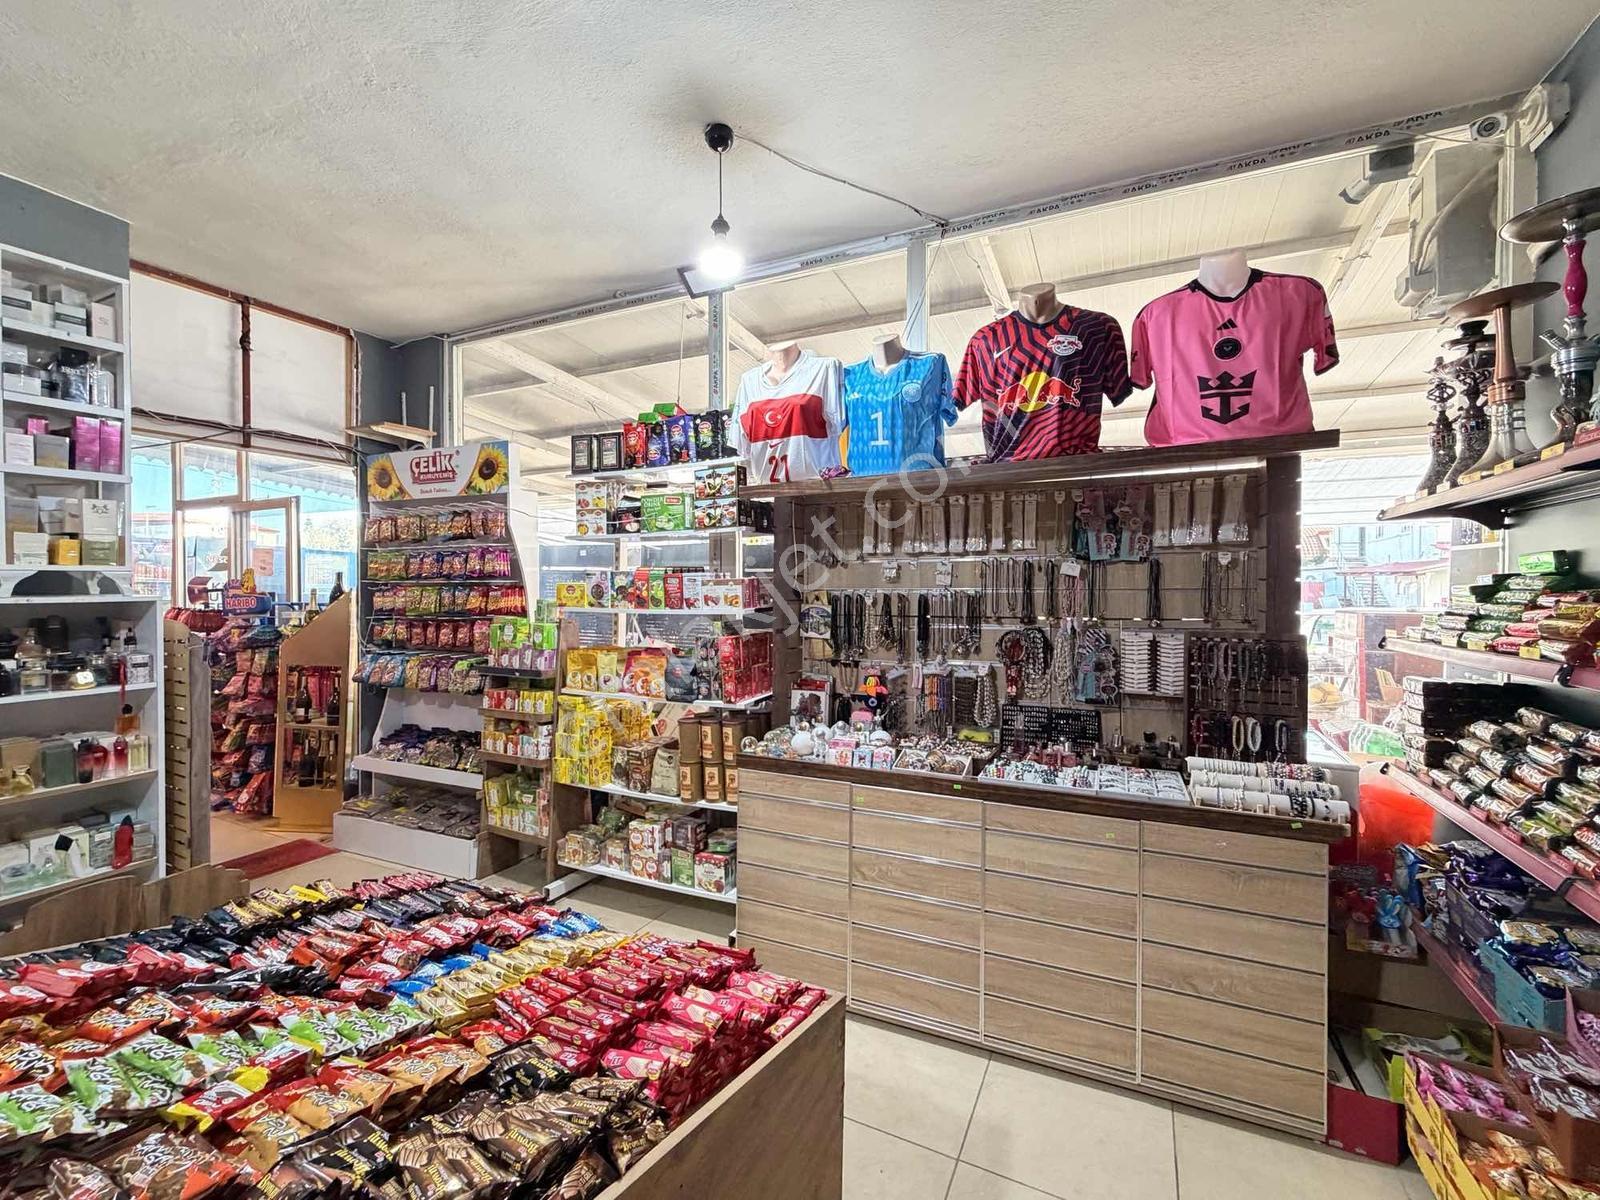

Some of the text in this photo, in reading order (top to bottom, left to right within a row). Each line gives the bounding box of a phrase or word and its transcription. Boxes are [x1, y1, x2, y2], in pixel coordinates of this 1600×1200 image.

[1356, 129, 1391, 144] AKPA
[1237, 157, 1267, 171] AKPA
[1036, 203, 1060, 214] AKPA
[869, 411, 890, 447] 1
[411, 451, 455, 477] ÇELİK
[768, 454, 790, 483] 21
[225, 597, 256, 609] HARIBO
[506, 1127, 539, 1155] Browni
